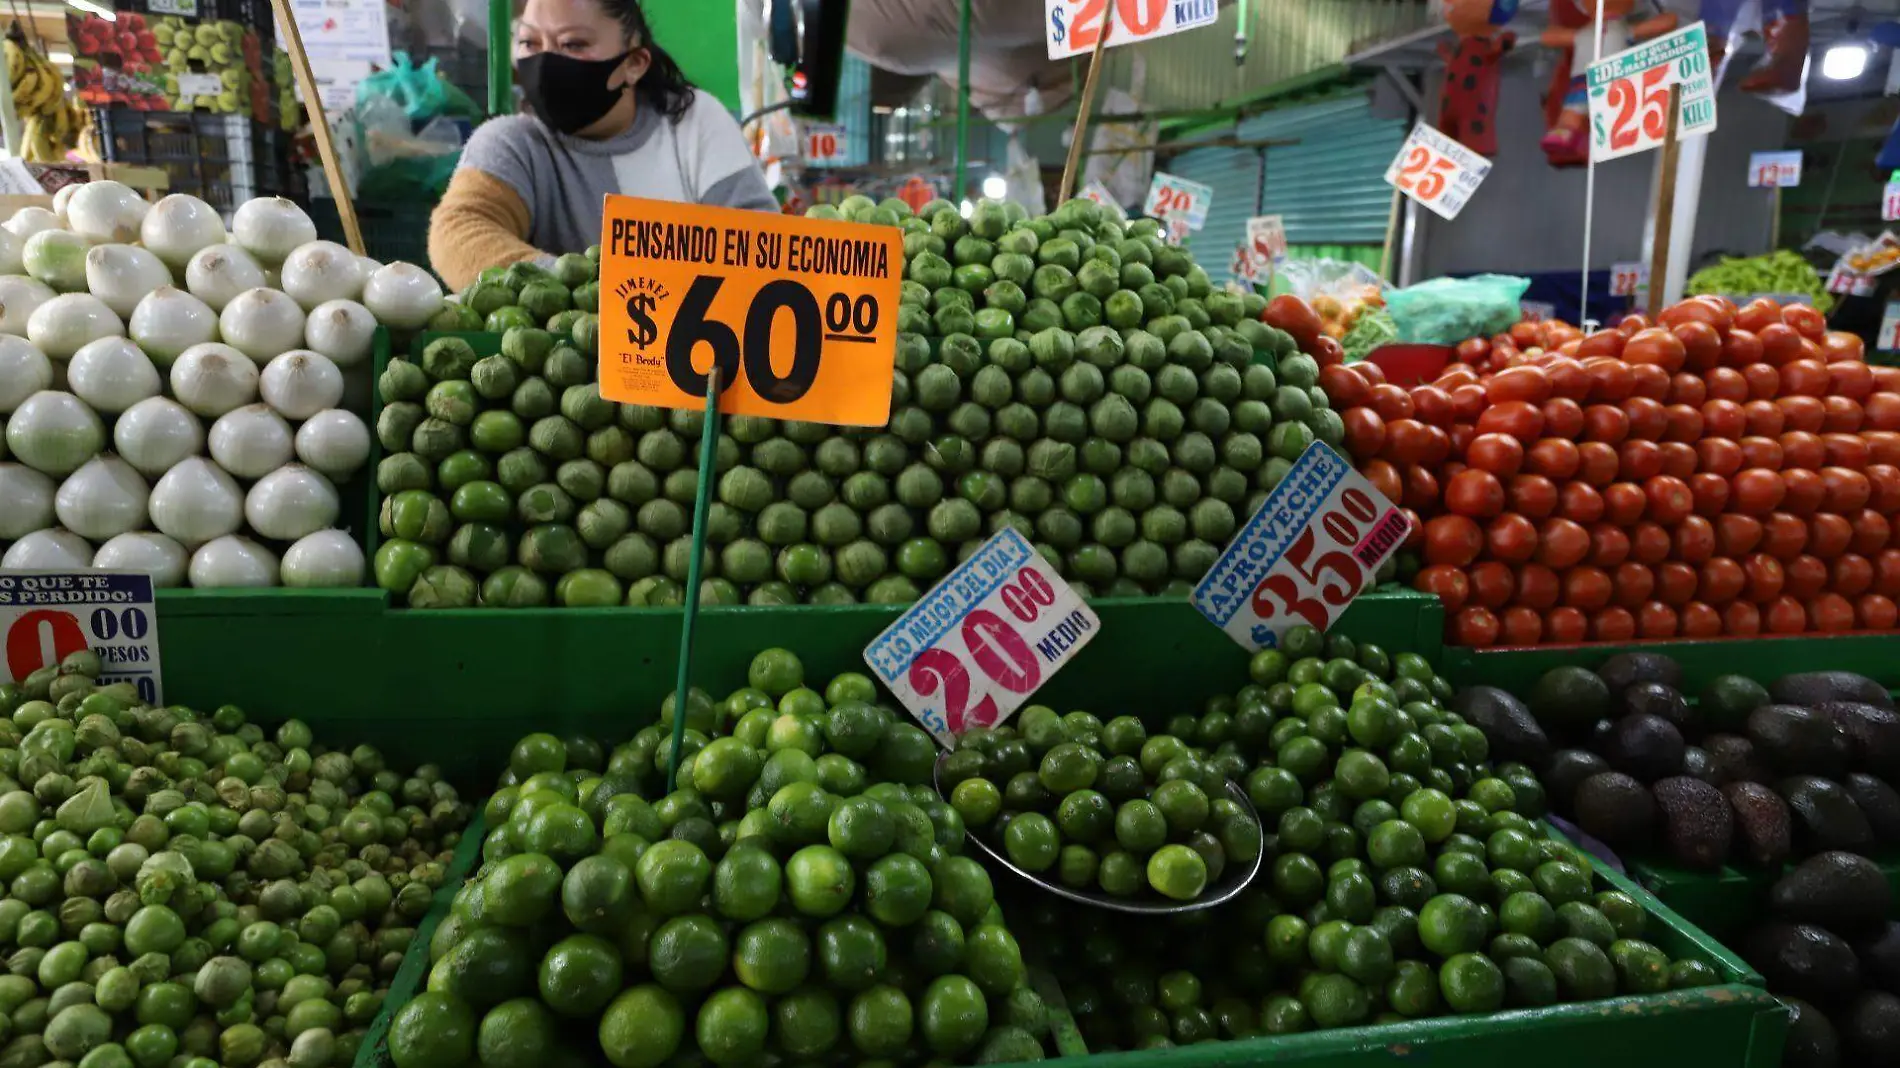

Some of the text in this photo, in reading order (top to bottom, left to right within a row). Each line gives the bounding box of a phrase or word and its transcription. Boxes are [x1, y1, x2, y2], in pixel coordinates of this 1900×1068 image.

[1051, 5, 1065, 46] $
[1175, 0, 1214, 24] KILO
[1679, 51, 1706, 80] 00
[1593, 63, 1671, 152] $ 25
[1683, 96, 1712, 127] KILO
[1395, 146, 1457, 201] 25
[610, 218, 889, 279] PENSANDO EN SU ECONOMIA
[626, 292, 658, 351] $
[665, 274, 822, 404] 60
[825, 291, 879, 334] 00
[1208, 457, 1334, 614] APROVECHE
[1321, 487, 1378, 547] 00
[1357, 512, 1408, 567] MEDIO
[18, 590, 134, 603] PERDIDO!
[21, 577, 73, 592] QUE
[79, 577, 109, 589] TE
[887, 548, 1013, 662] LO MEJOR DEL DIA
[1000, 566, 1056, 623] 00
[1251, 524, 1364, 634] 35
[90, 607, 149, 641] 00
[1036, 609, 1092, 663] MEDIO
[96, 645, 150, 663] PESOS
[908, 608, 1041, 734] 20
